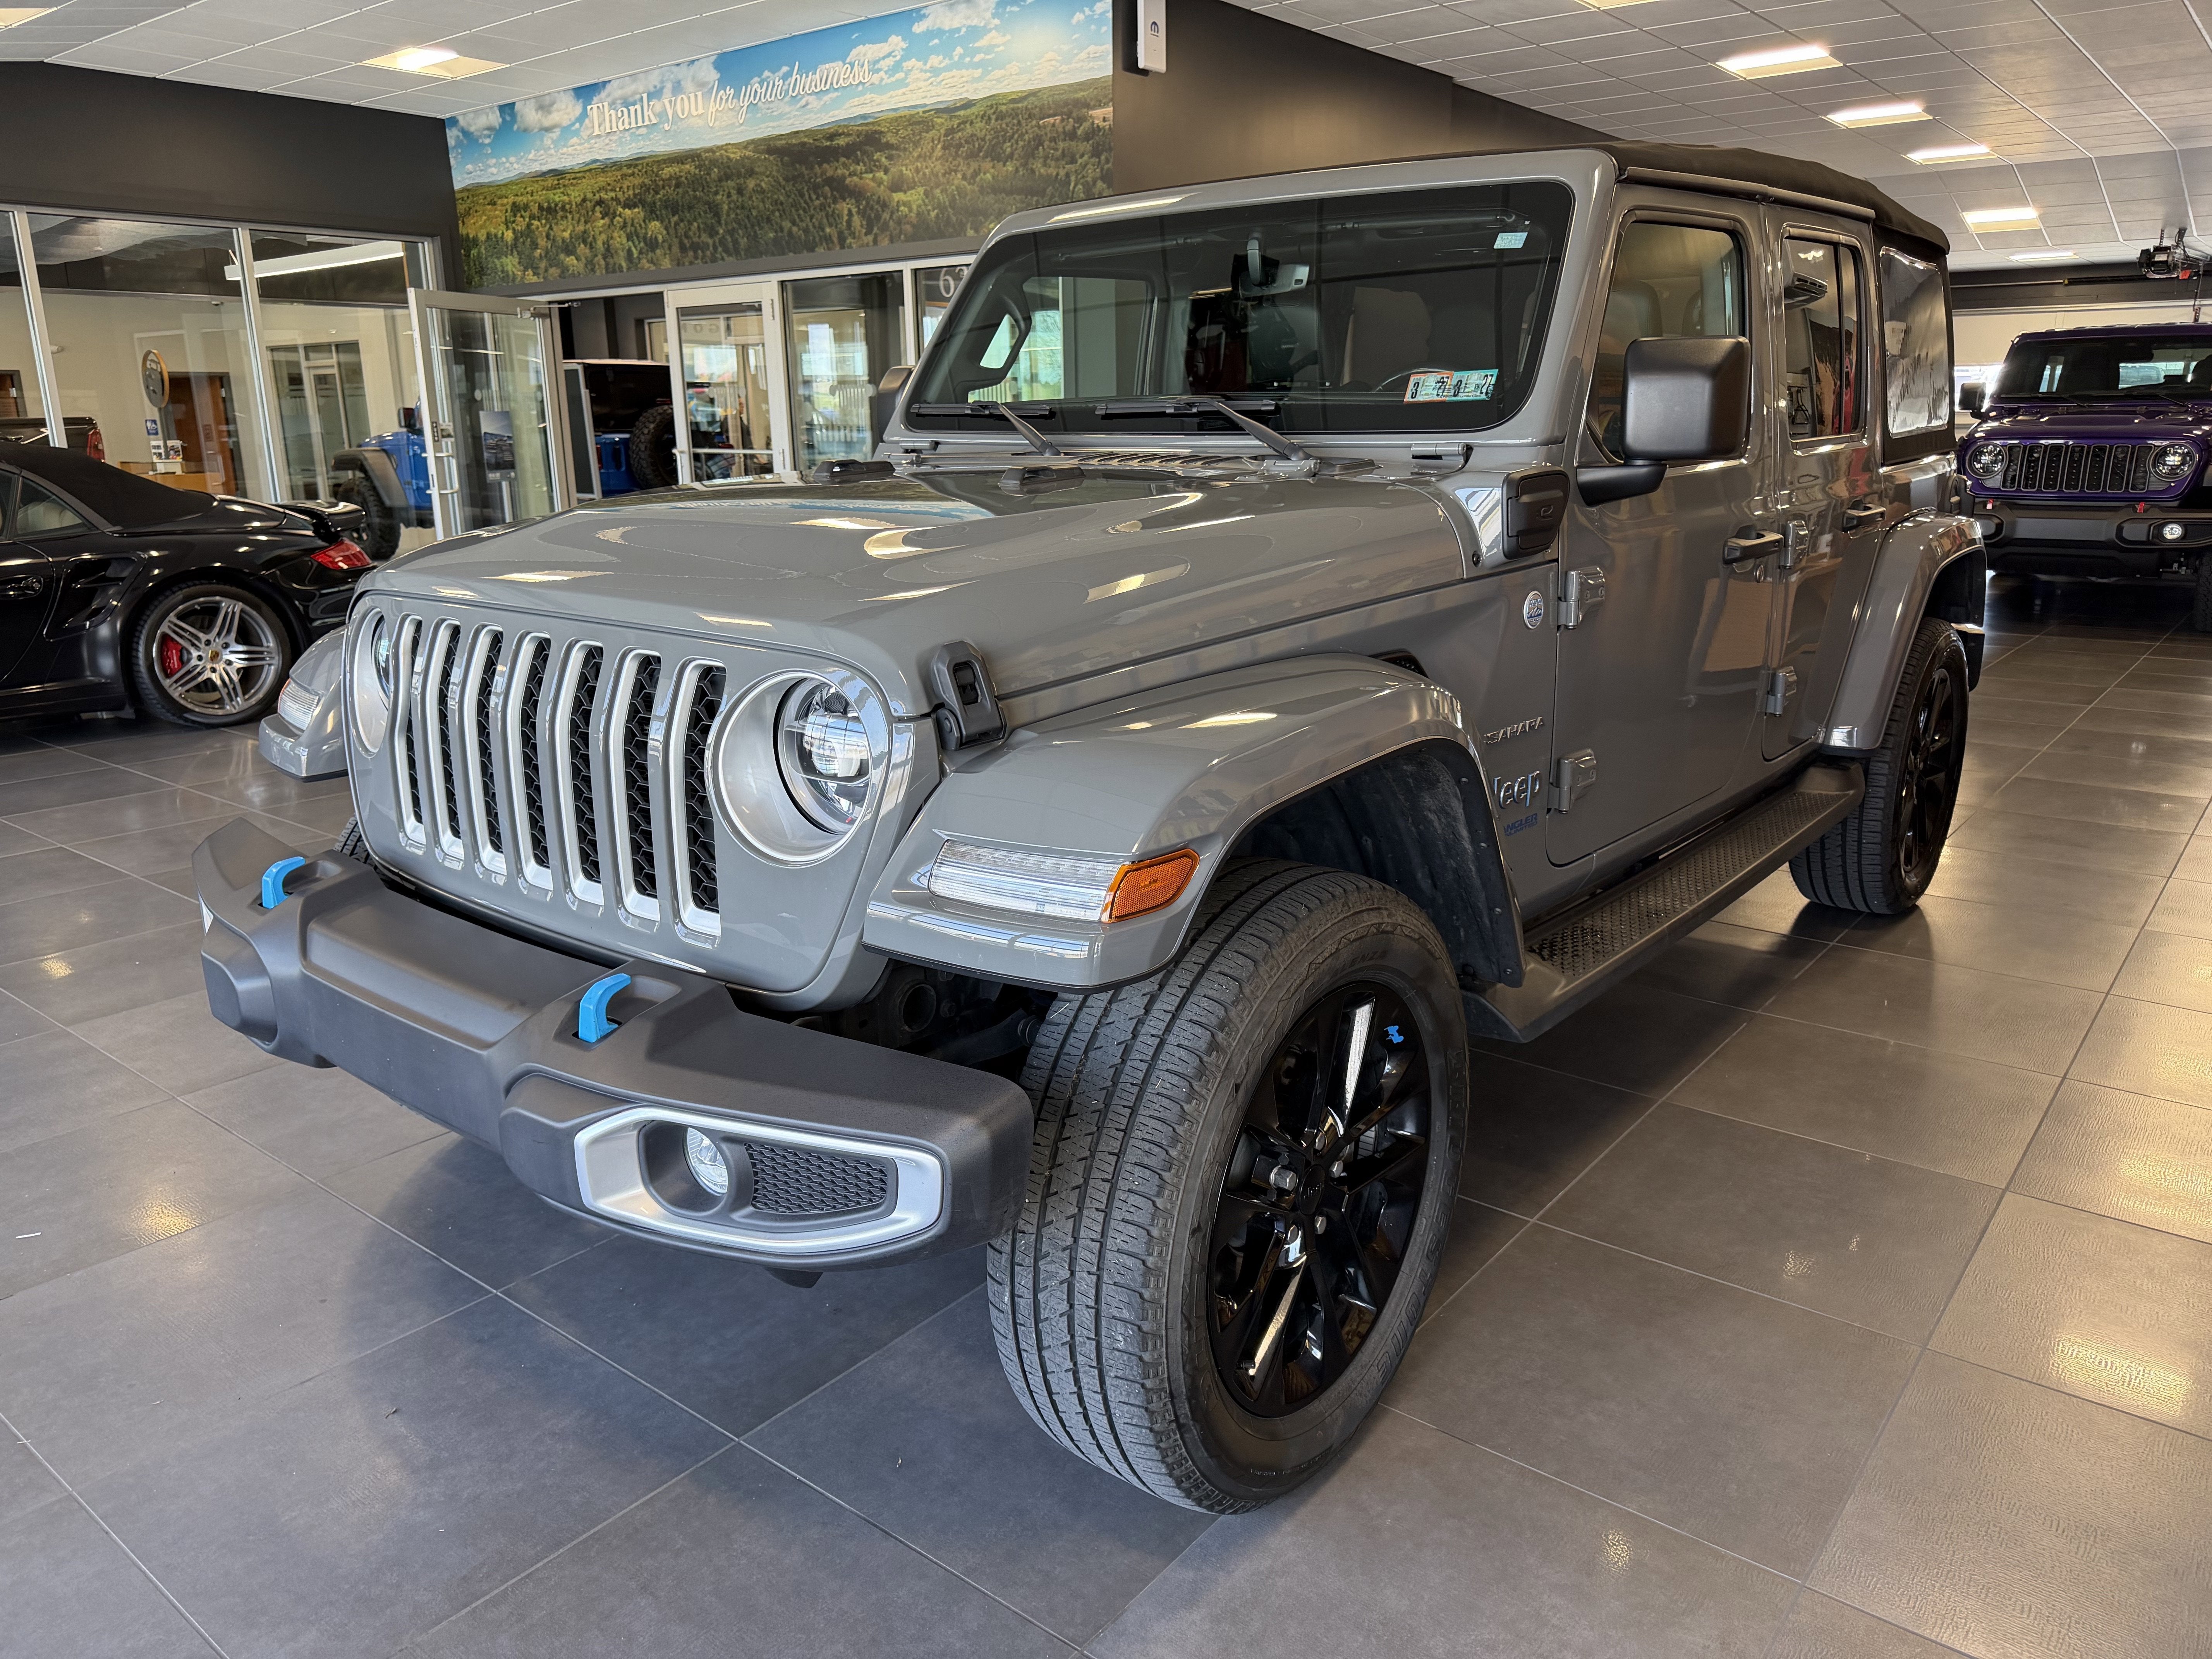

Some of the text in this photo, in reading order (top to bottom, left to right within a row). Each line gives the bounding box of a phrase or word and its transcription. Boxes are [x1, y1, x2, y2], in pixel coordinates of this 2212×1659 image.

[587, 59, 872, 136] Thank you for your business
[1410, 381, 1420, 399] 3
[1479, 374, 1494, 396] 27
[1484, 716, 1544, 744] SAHARA
[1493, 771, 1541, 809] Jeep
